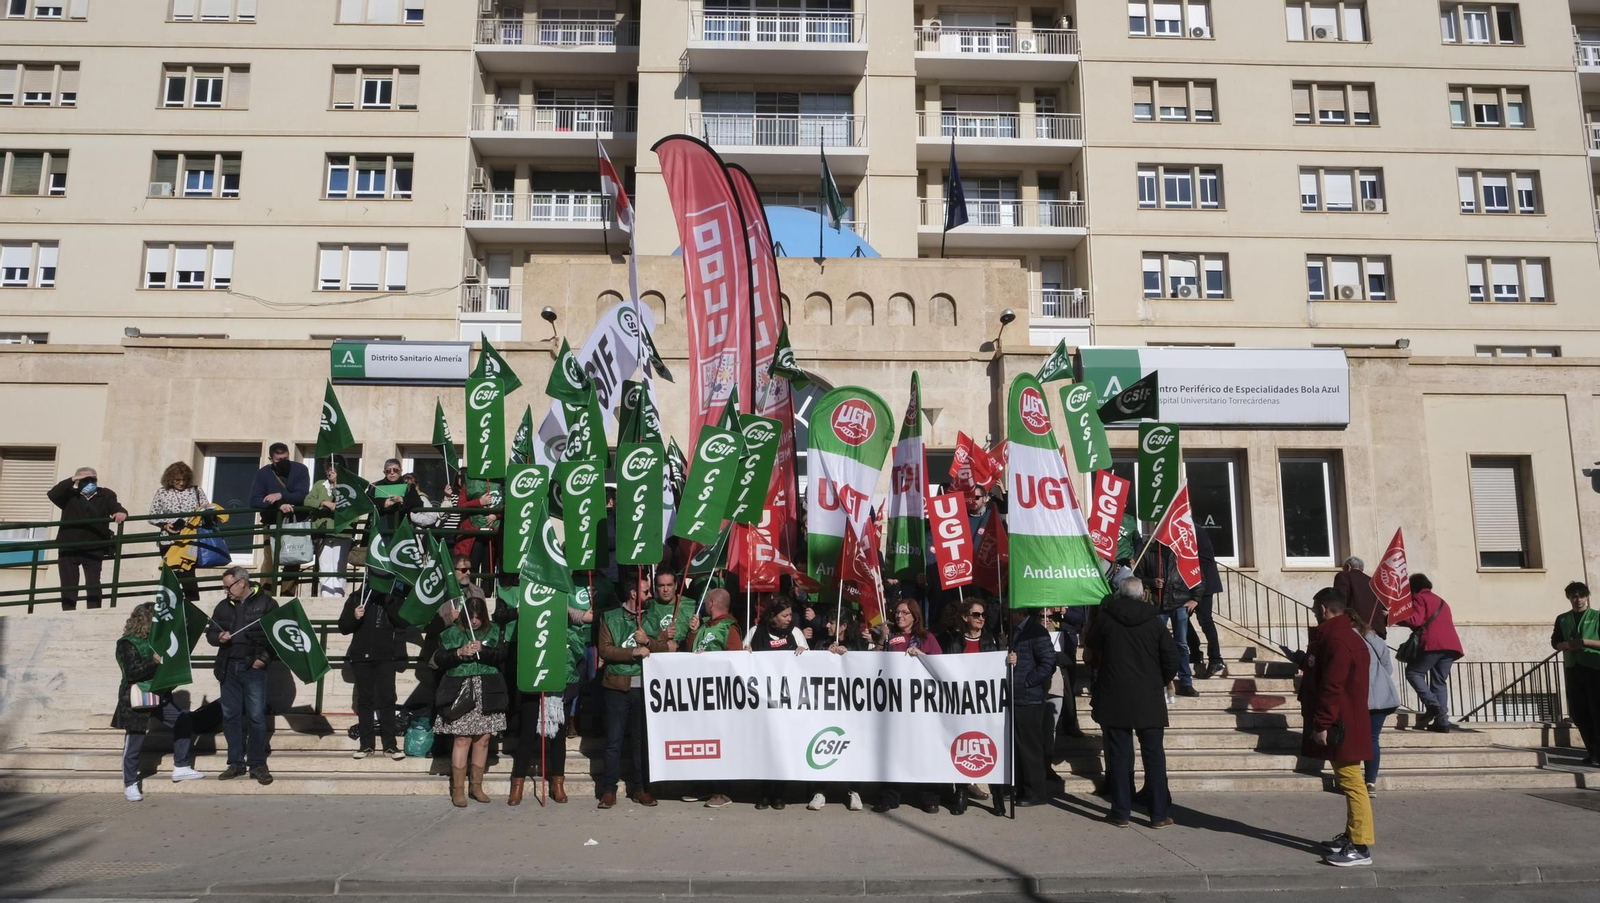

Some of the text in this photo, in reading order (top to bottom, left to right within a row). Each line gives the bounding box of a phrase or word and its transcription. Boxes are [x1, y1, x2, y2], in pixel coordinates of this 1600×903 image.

[371, 354, 462, 363] Distrito Sanitario Almería
[584, 333, 617, 411] SIF
[475, 390, 500, 400] CSIF
[1071, 391, 1092, 404] CSIF
[1123, 388, 1152, 404] CSIF
[1159, 384, 1340, 395] ntro Periférico de Especialidades Bola Azul
[1159, 396, 1280, 405] spital Universitario Torrecárdenas
[839, 404, 873, 427] UGT
[480, 413, 491, 475] CSIF
[747, 429, 776, 442] CSIF
[1080, 412, 1098, 469] CSIF
[1149, 433, 1174, 445] CSIF
[707, 442, 737, 456] CSIF
[629, 458, 658, 470] CSIF
[517, 477, 544, 489] CSIF
[572, 473, 599, 485] CSIF
[732, 454, 761, 519] CSIF
[1151, 457, 1166, 519] CSIF
[687, 469, 720, 535] CSIF
[817, 477, 870, 524] UGT
[1097, 474, 1122, 533] UGT
[632, 484, 648, 560] CSIF
[934, 497, 965, 561] UGT
[579, 498, 593, 566] CSIF
[1023, 564, 1100, 579] Andalucía
[154, 593, 174, 622] CSIF
[534, 611, 553, 687] CSIF
[649, 669, 1010, 715] SALVEMOS LA ATENCIÓN PRIMARIA
[668, 743, 717, 757] CCOO
[814, 740, 851, 755] CSIF
[955, 738, 991, 756] UGT
